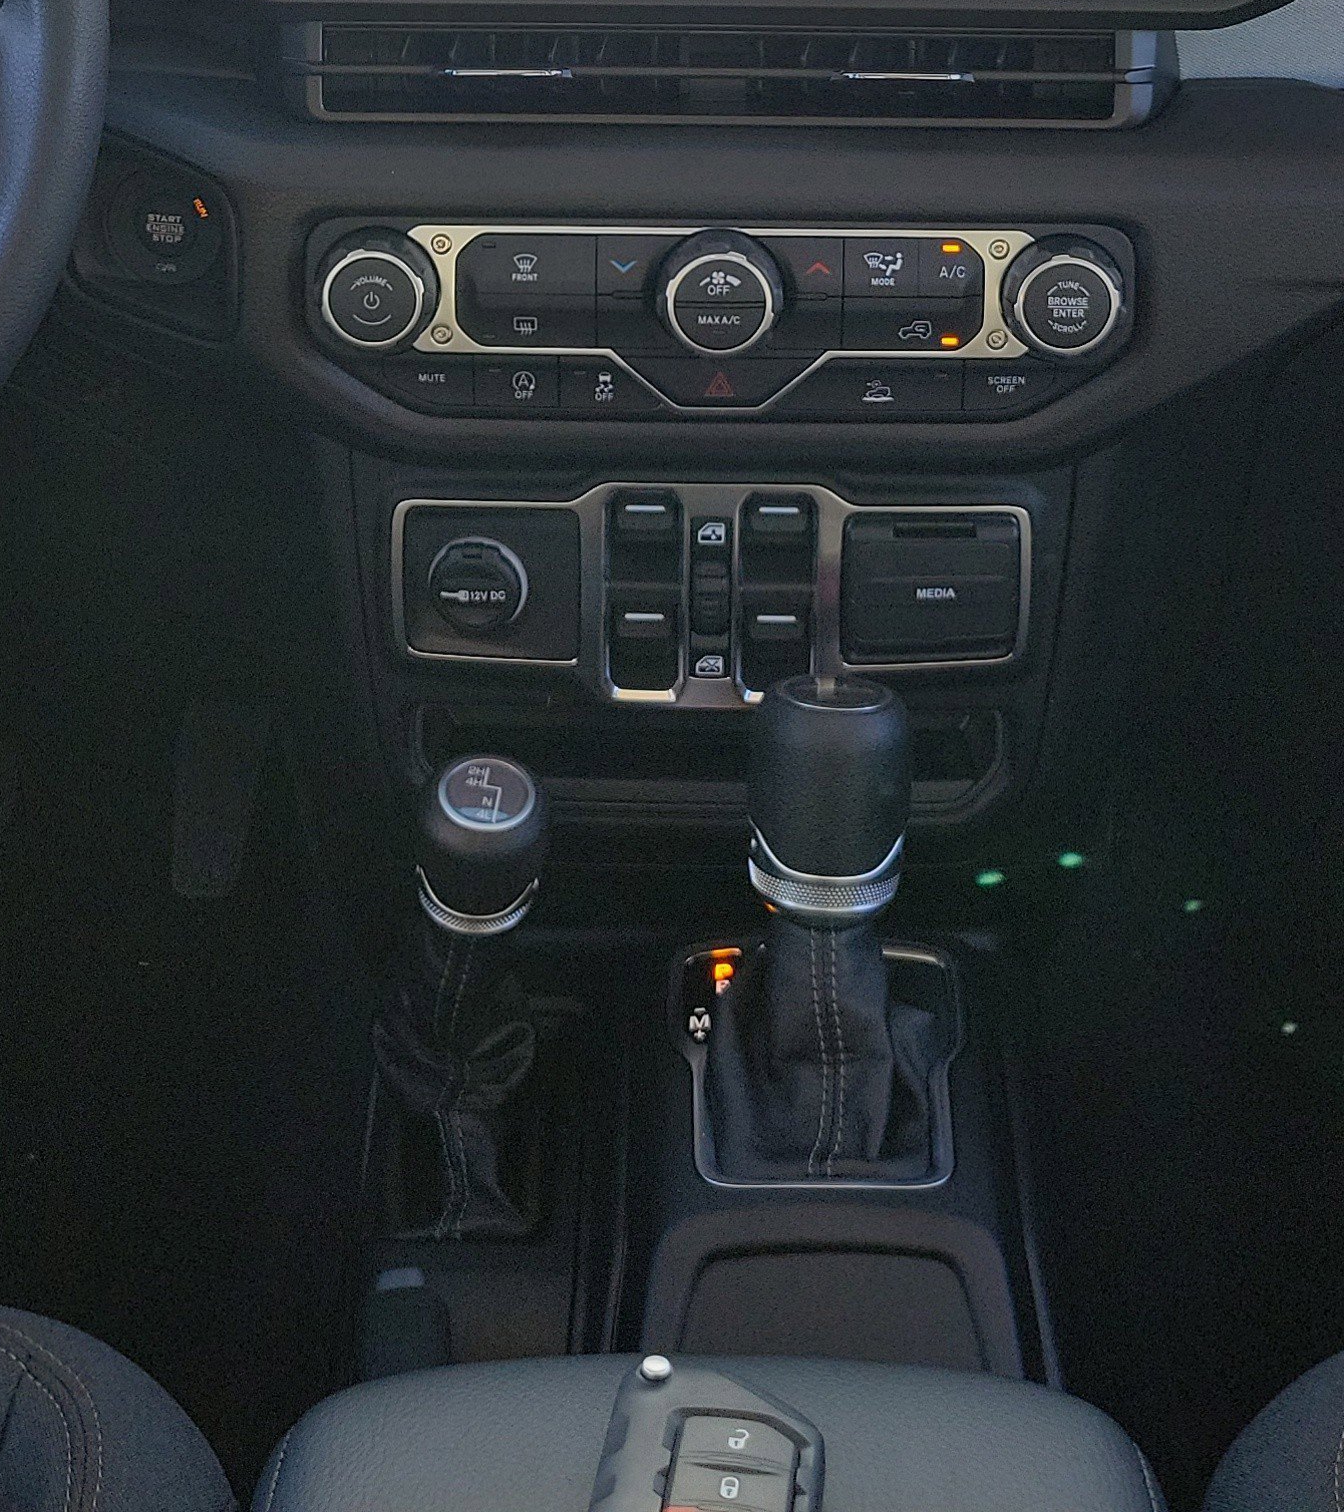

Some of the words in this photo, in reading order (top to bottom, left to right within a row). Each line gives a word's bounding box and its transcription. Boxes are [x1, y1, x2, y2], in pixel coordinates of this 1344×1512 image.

[148, 213, 182, 223] START
[152, 234, 183, 243] STOP
[939, 265, 966, 279] A/C
[355, 275, 388, 288] VOLUME
[511, 273, 538, 282] FRONT
[871, 277, 895, 287] MODE
[1058, 280, 1079, 290] TUNE
[707, 285, 730, 296] OFF
[1047, 296, 1089, 306] BROWSE
[1053, 308, 1085, 319] ENTER
[698, 315, 720, 325] MAX
[722, 315, 741, 325] A/C
[1051, 320, 1084, 333] SCROLL
[418, 373, 446, 383] MUTE
[987, 376, 1025, 385] SCREEN
[996, 384, 1016, 394] OFF
[514, 391, 534, 400] OFF
[595, 392, 613, 402] OFF
[469, 590, 489, 601] 12V
[490, 590, 506, 600] DC
[916, 588, 955, 599] MEDIA
[482, 796, 493, 807] N
[715, 963, 734, 981] P
[689, 1013, 712, 1030] M
